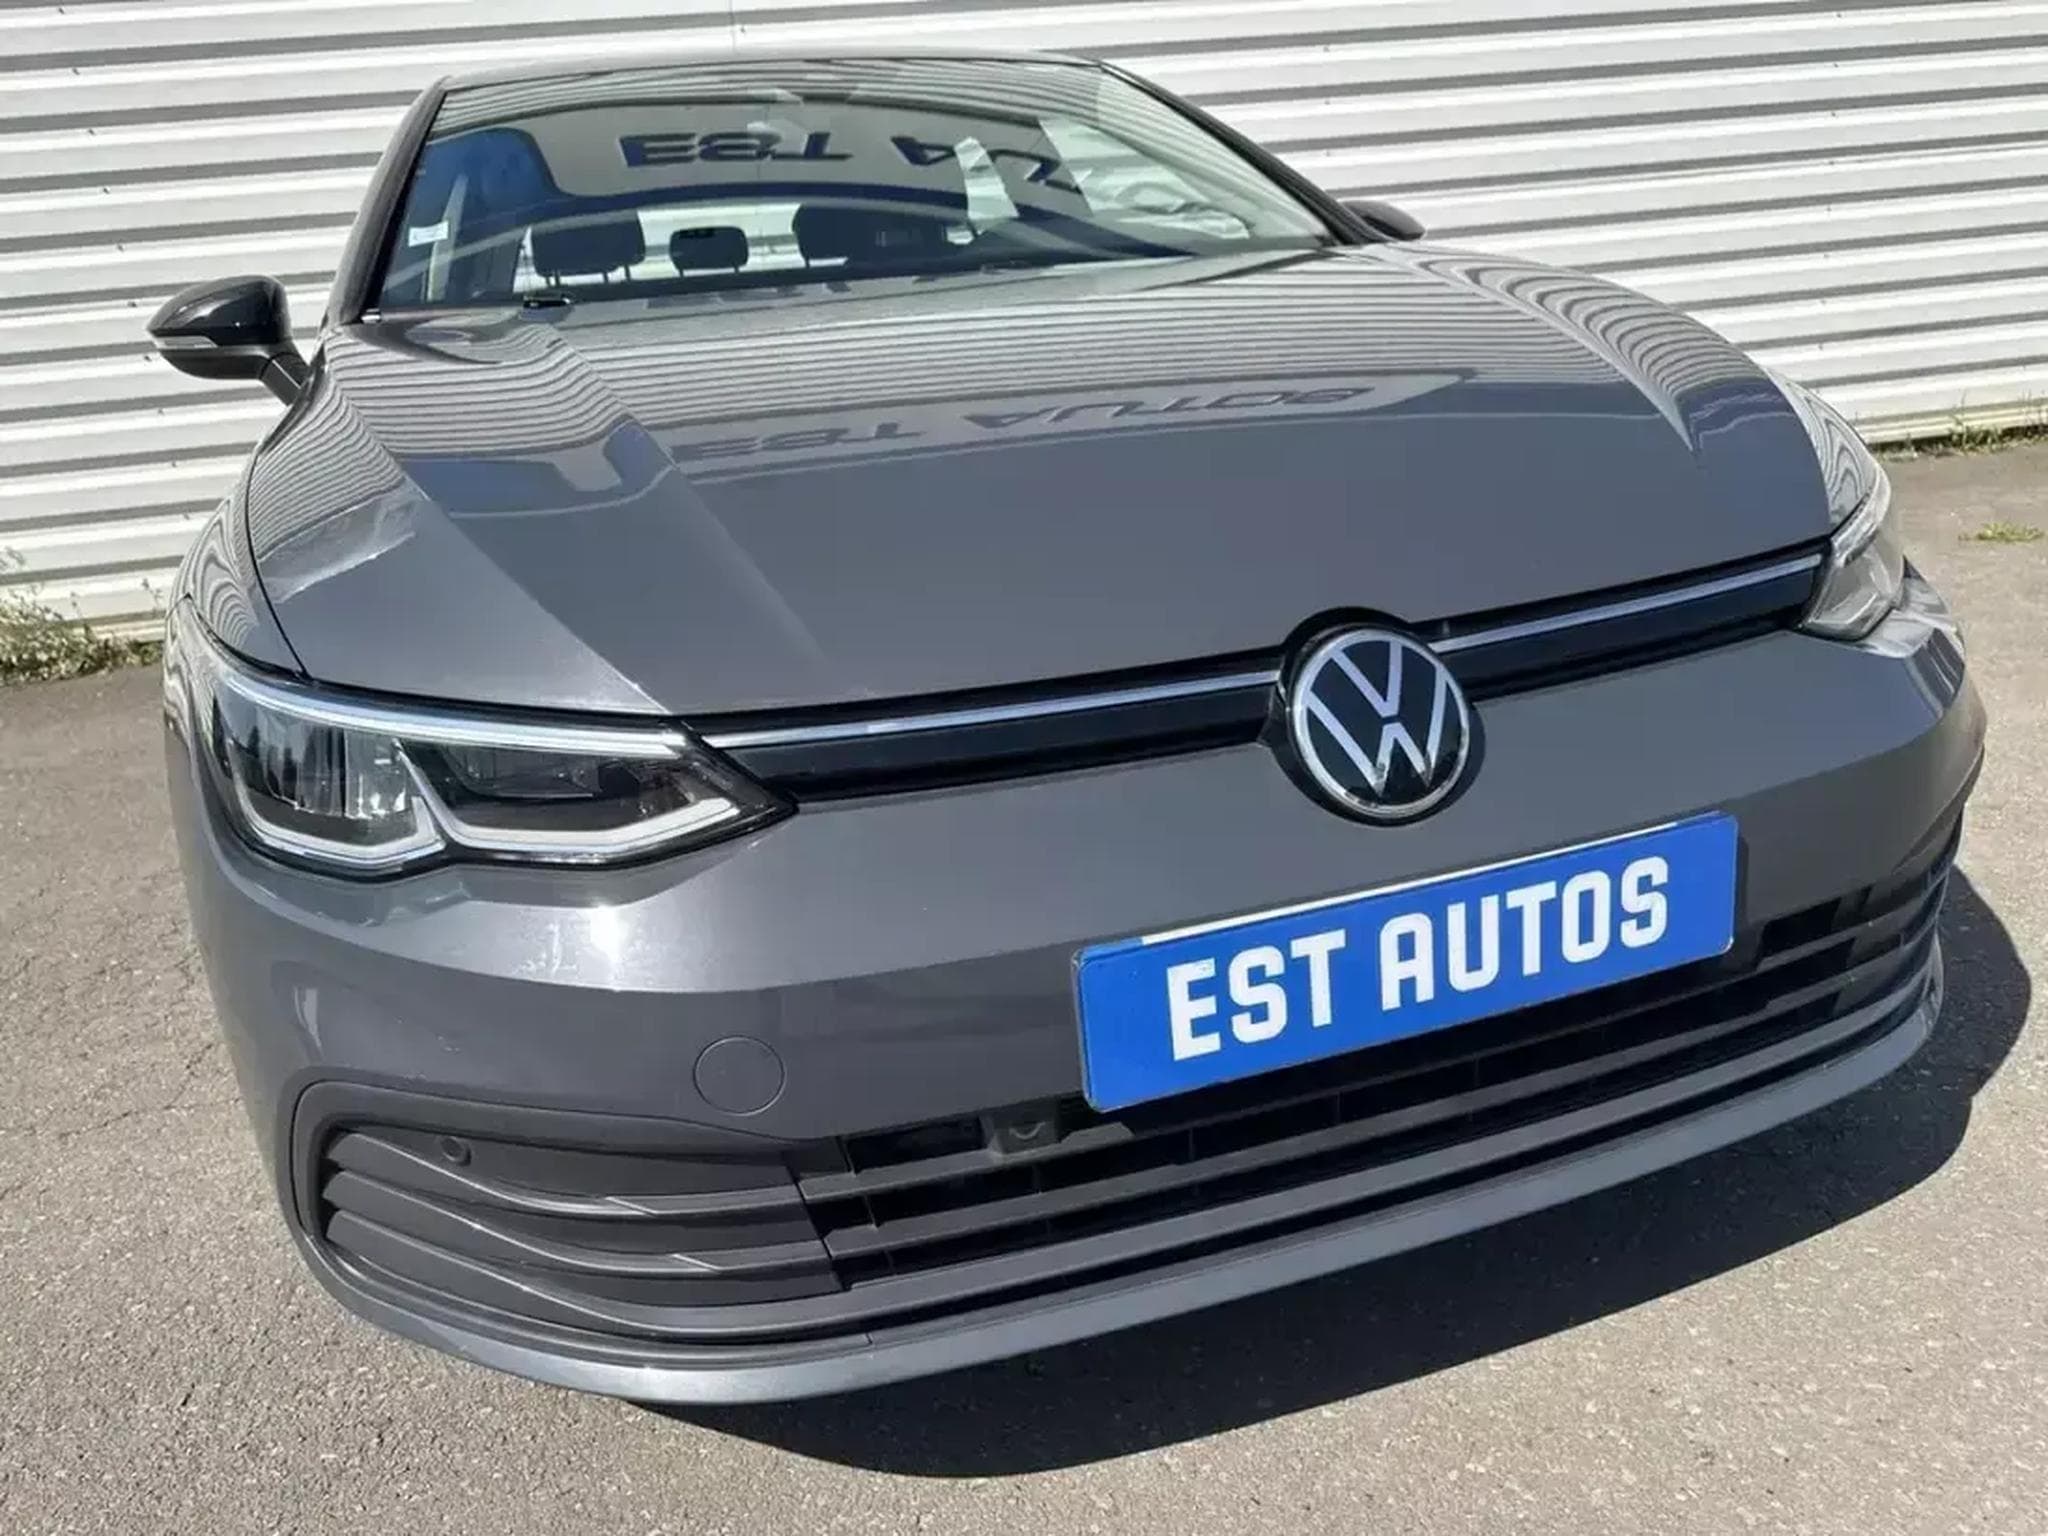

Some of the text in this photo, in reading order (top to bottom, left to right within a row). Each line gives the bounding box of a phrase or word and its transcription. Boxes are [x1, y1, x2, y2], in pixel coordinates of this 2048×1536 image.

[1300, 636, 1453, 798] VW
[1167, 855, 1669, 1061] EST AUTOS
